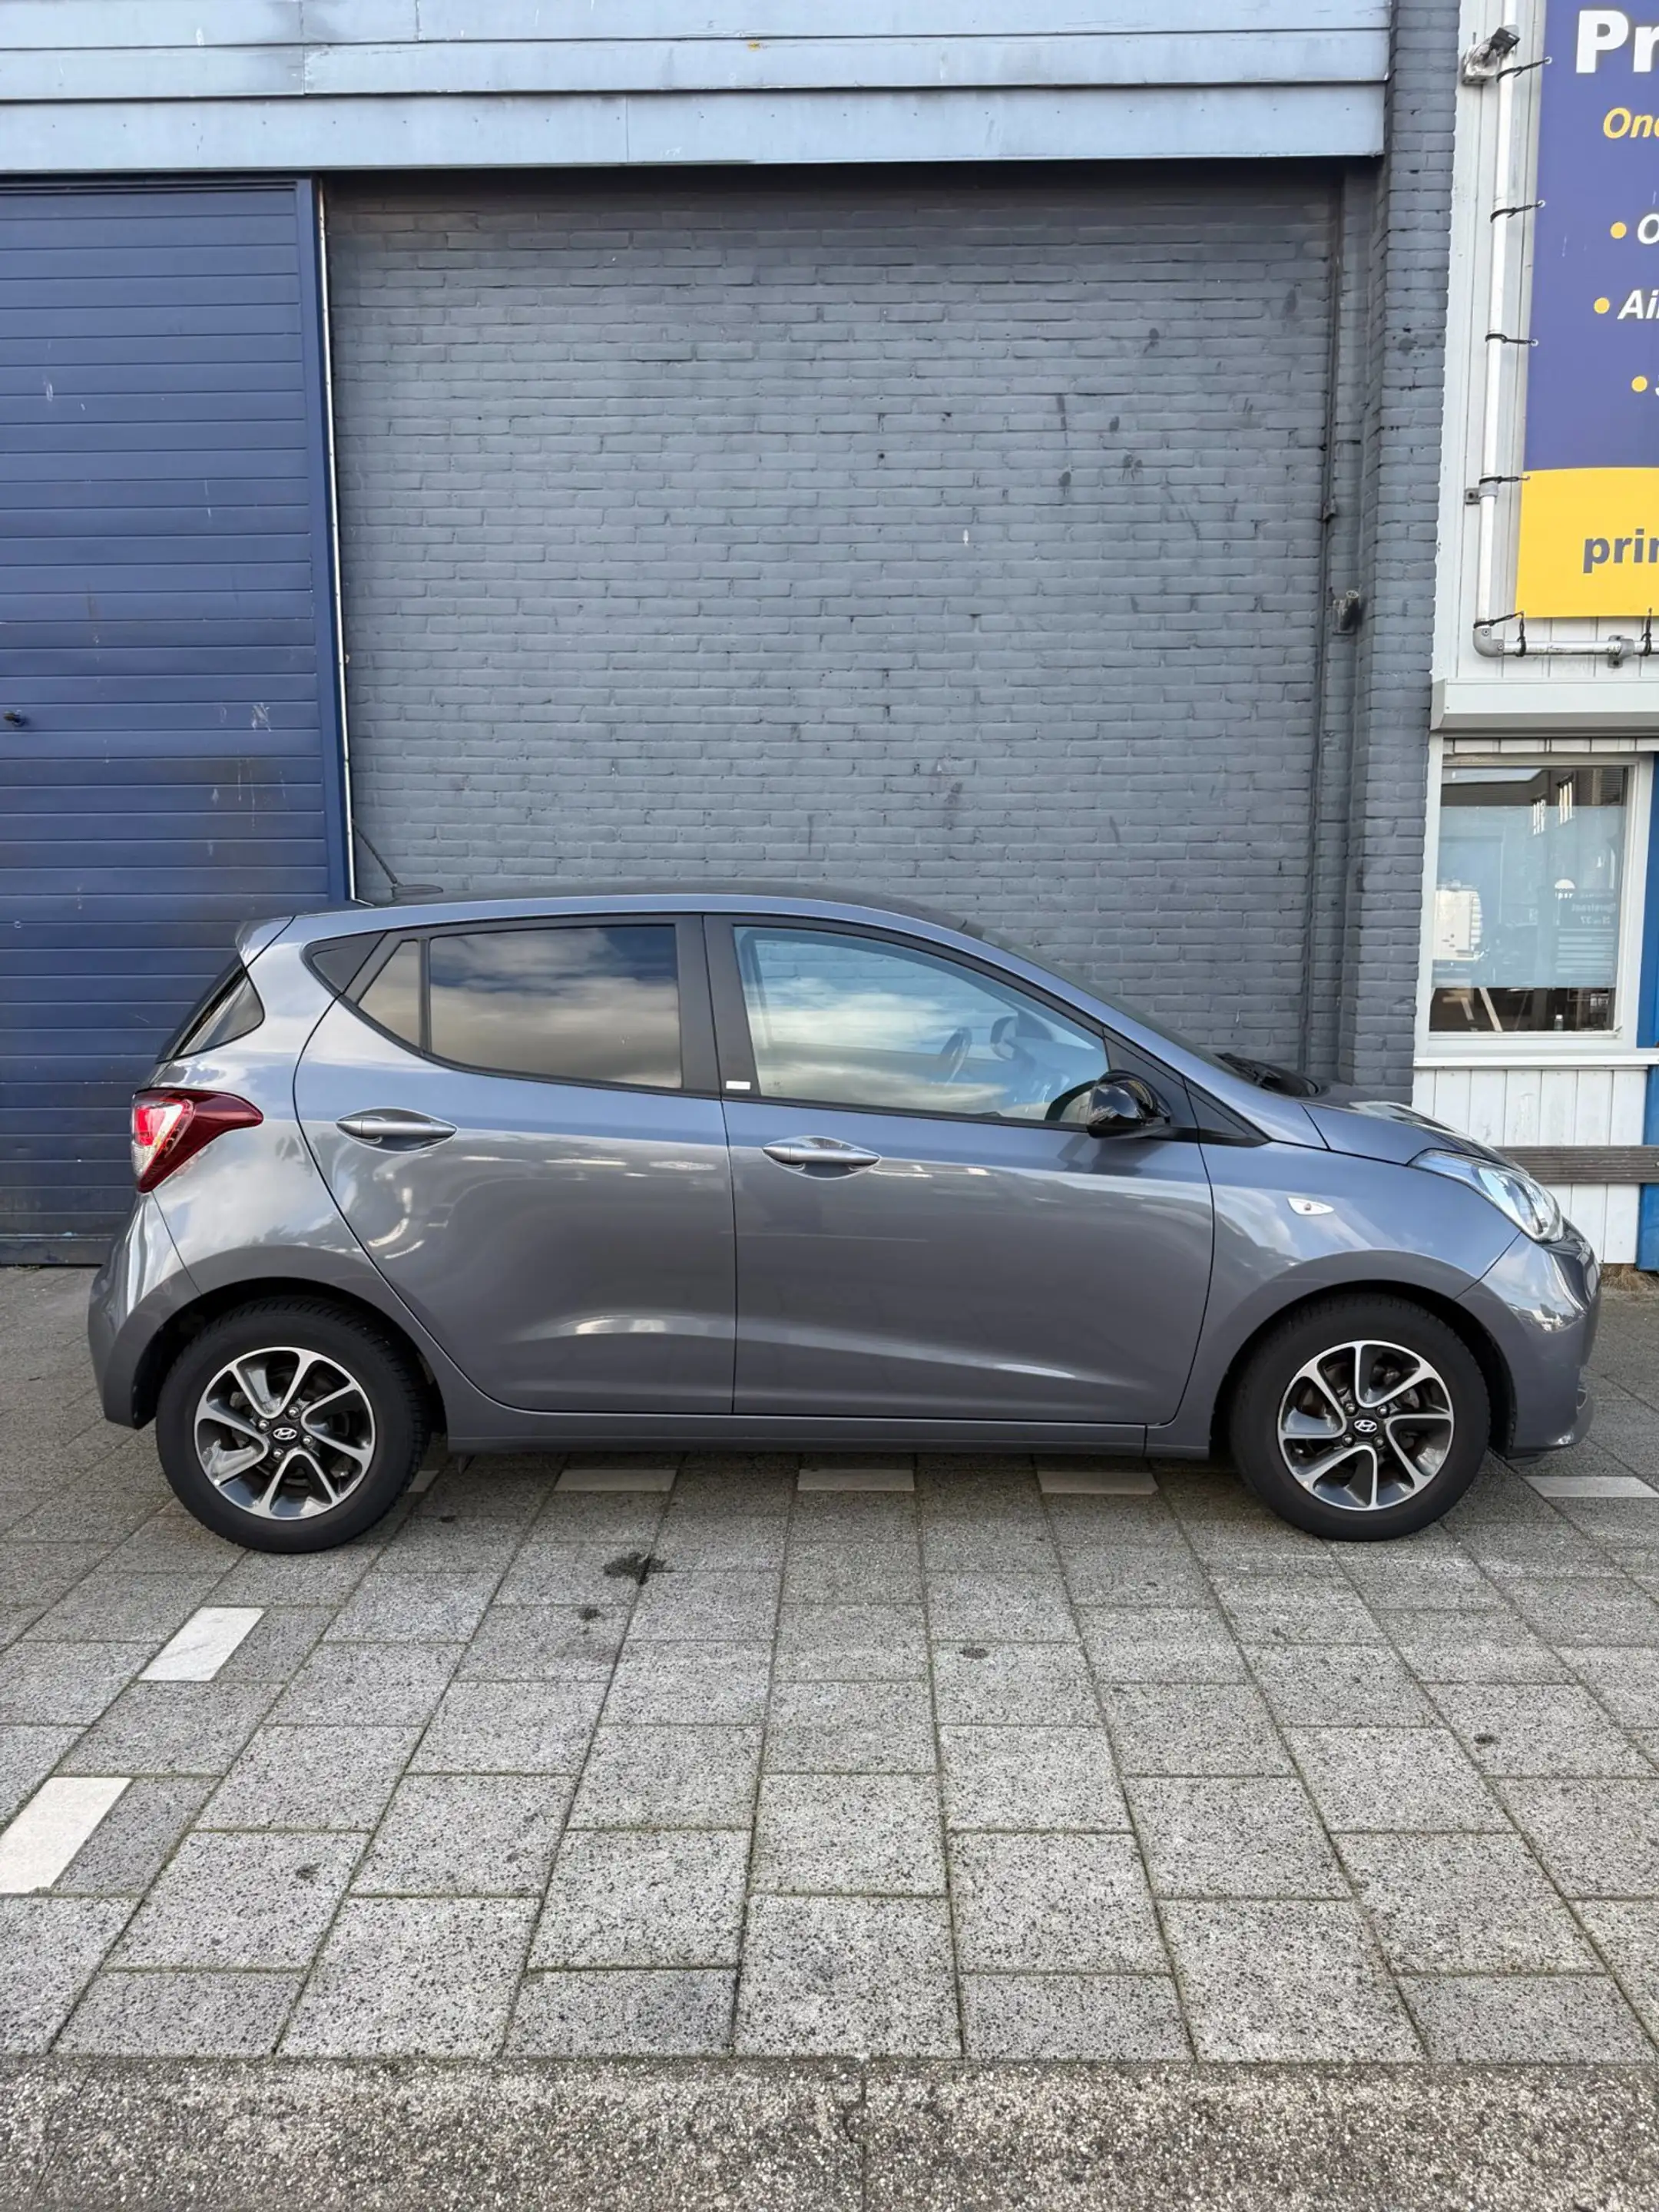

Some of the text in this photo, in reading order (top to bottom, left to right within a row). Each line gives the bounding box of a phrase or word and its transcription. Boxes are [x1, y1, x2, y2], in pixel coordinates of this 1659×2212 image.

[1575, 10, 1659, 74] Pr
[1603, 107, 1659, 139] On
[1616, 289, 1659, 320] Ai
